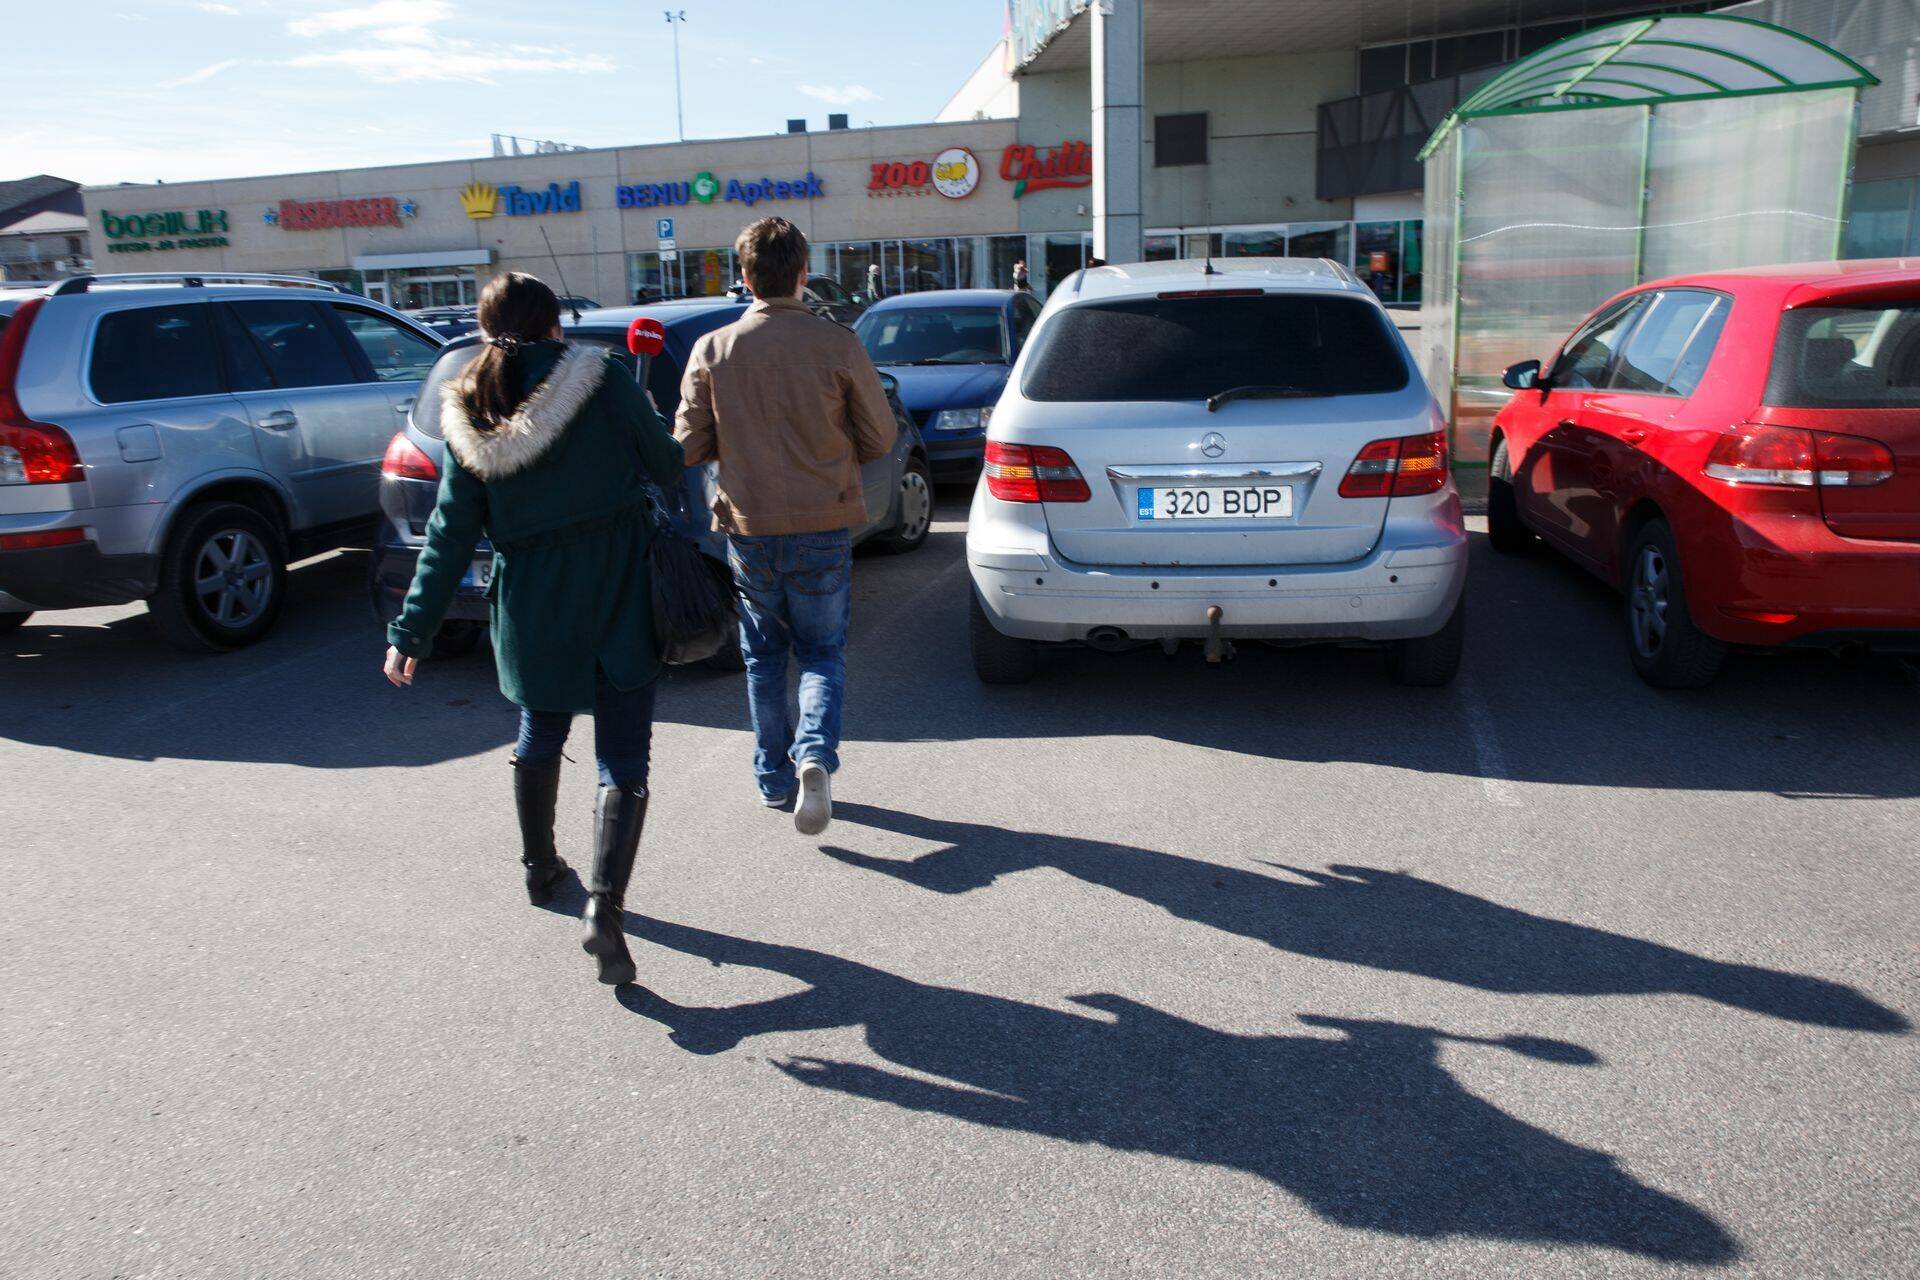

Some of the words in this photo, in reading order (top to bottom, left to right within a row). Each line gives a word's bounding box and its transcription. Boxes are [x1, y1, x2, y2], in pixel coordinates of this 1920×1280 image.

[868, 160, 929, 189] ZOO
[498, 180, 582, 216] Tavid
[616, 181, 689, 209] BENU
[724, 171, 826, 207] Apteek
[660, 220, 671, 238] P
[1139, 508, 1153, 516] EST
[1165, 490, 1210, 515] 320
[1223, 489, 1282, 514] BDP
